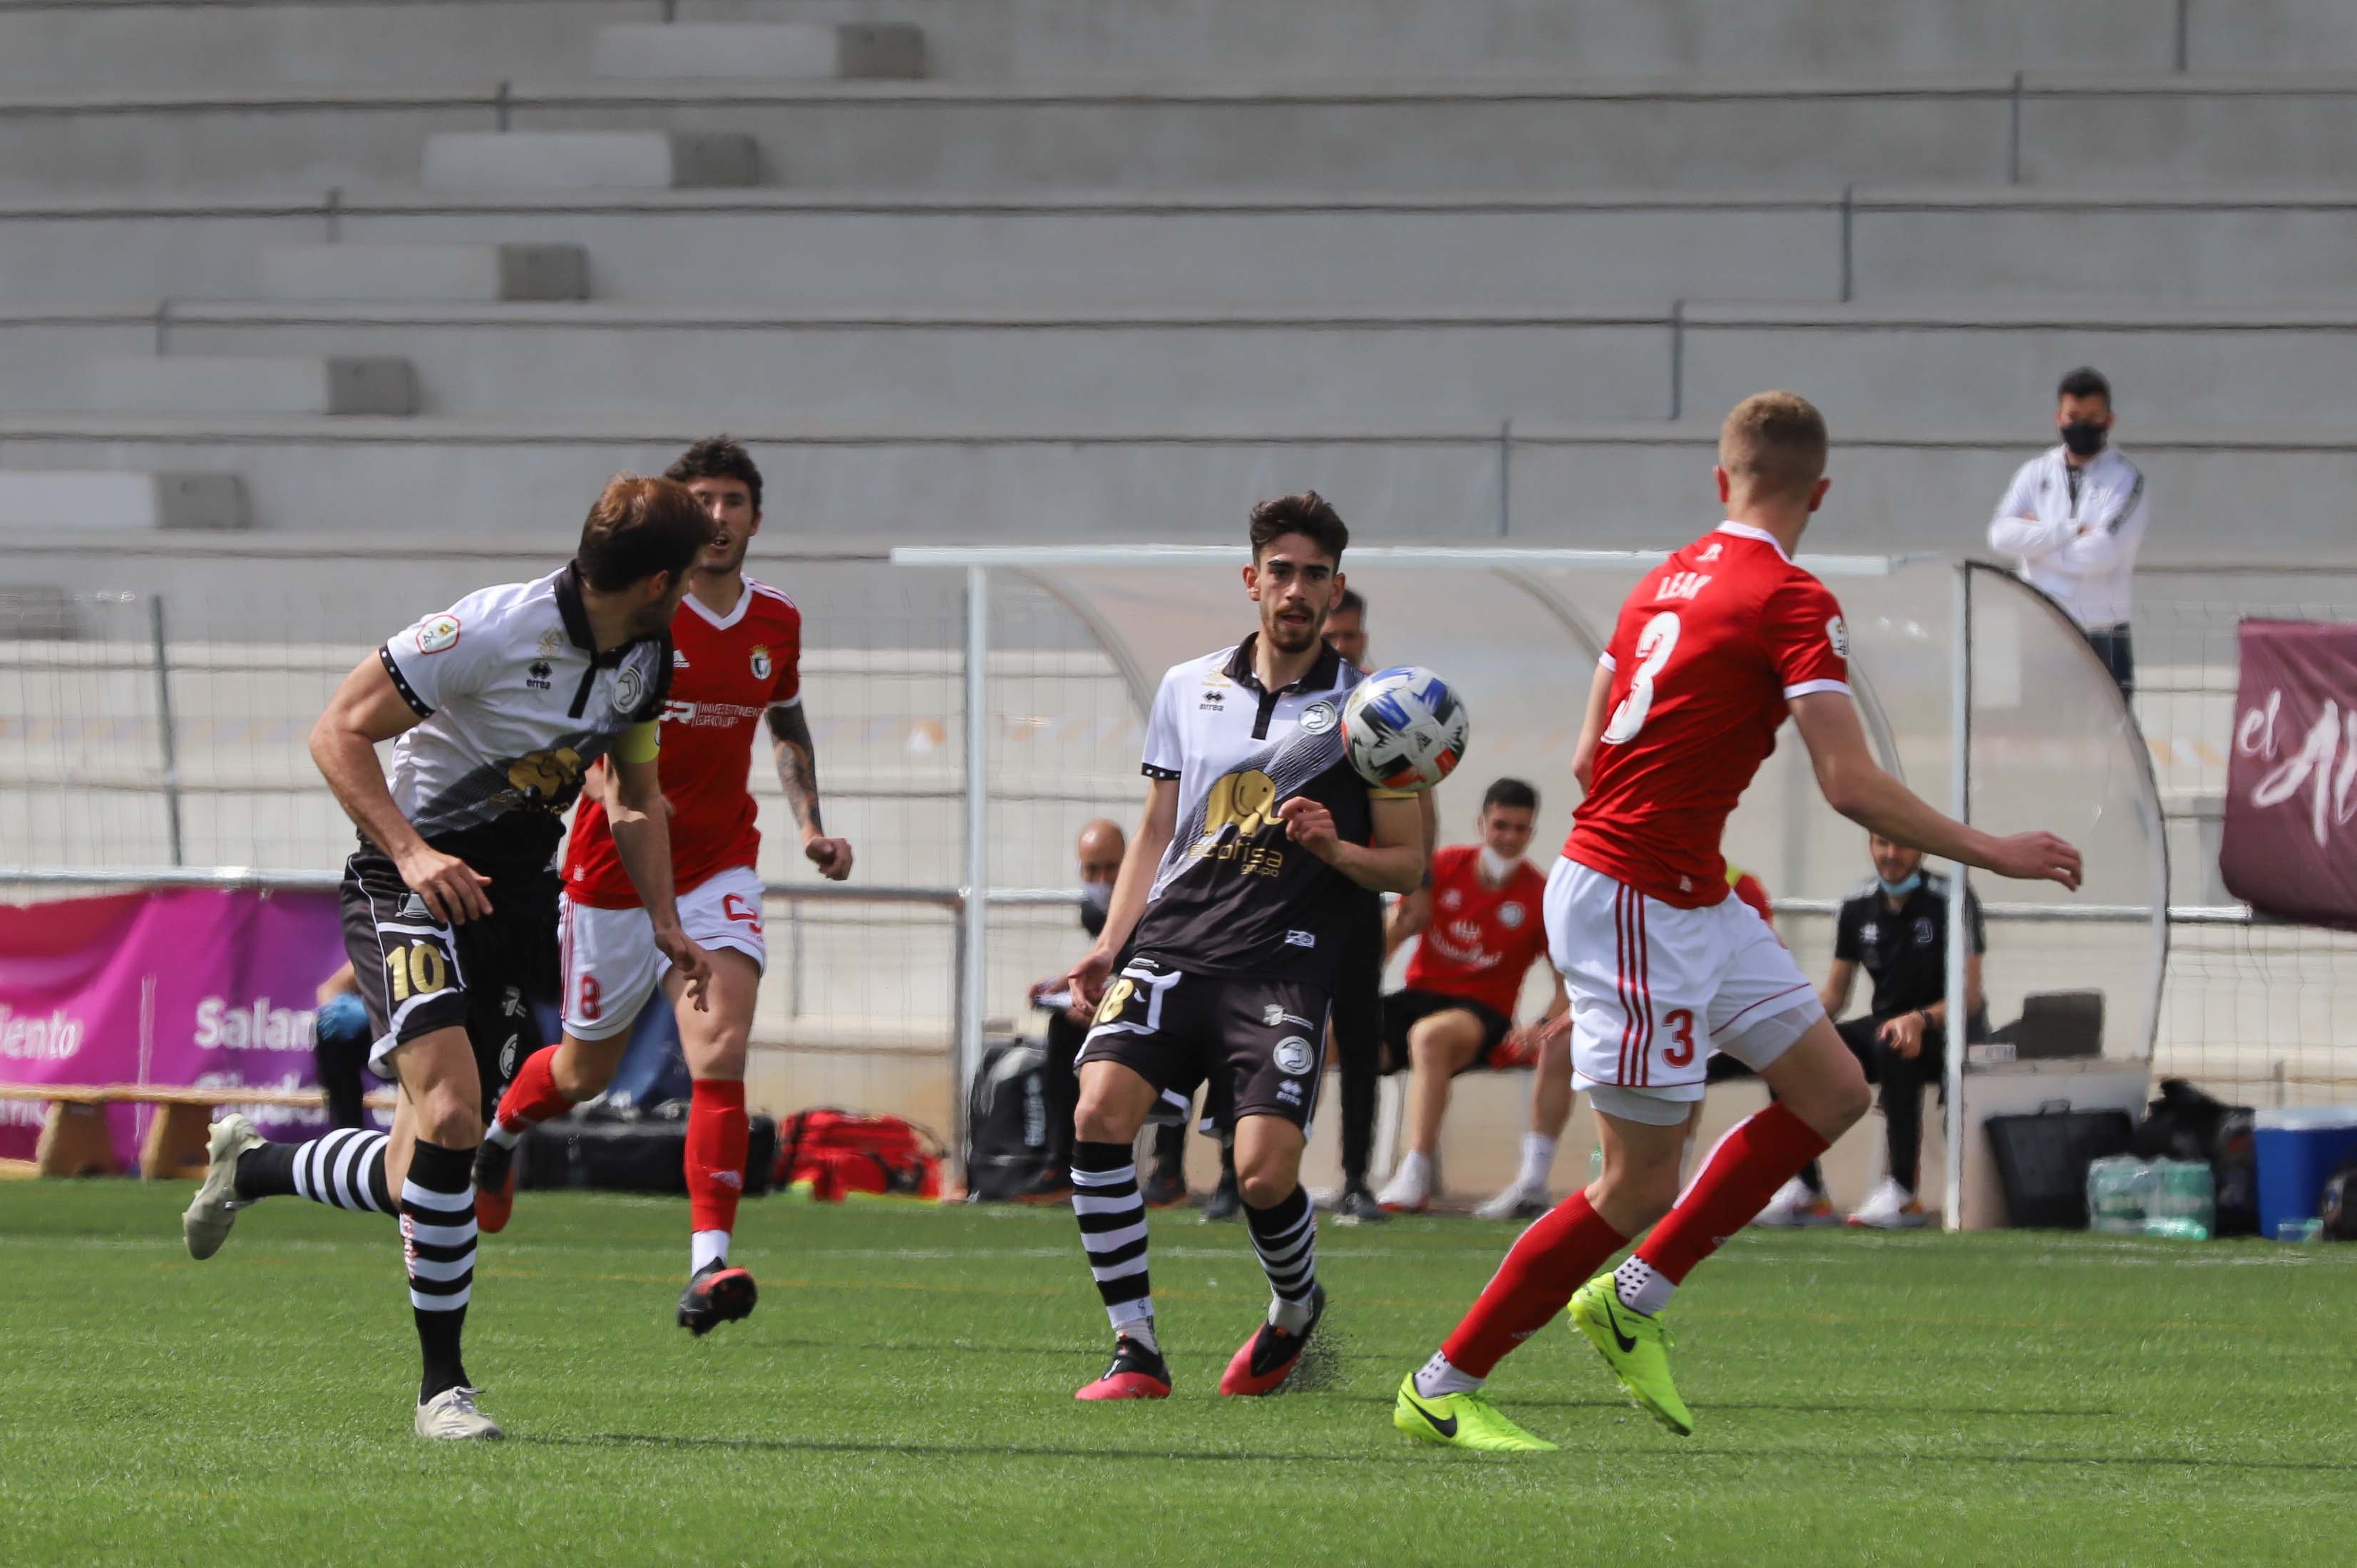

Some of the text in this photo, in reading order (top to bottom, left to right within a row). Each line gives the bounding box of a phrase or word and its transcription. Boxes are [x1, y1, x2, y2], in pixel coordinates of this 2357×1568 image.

[1600, 611, 1681, 745] 3
[386, 944, 445, 1002] 10
[1661, 1008, 1695, 1069] 3
